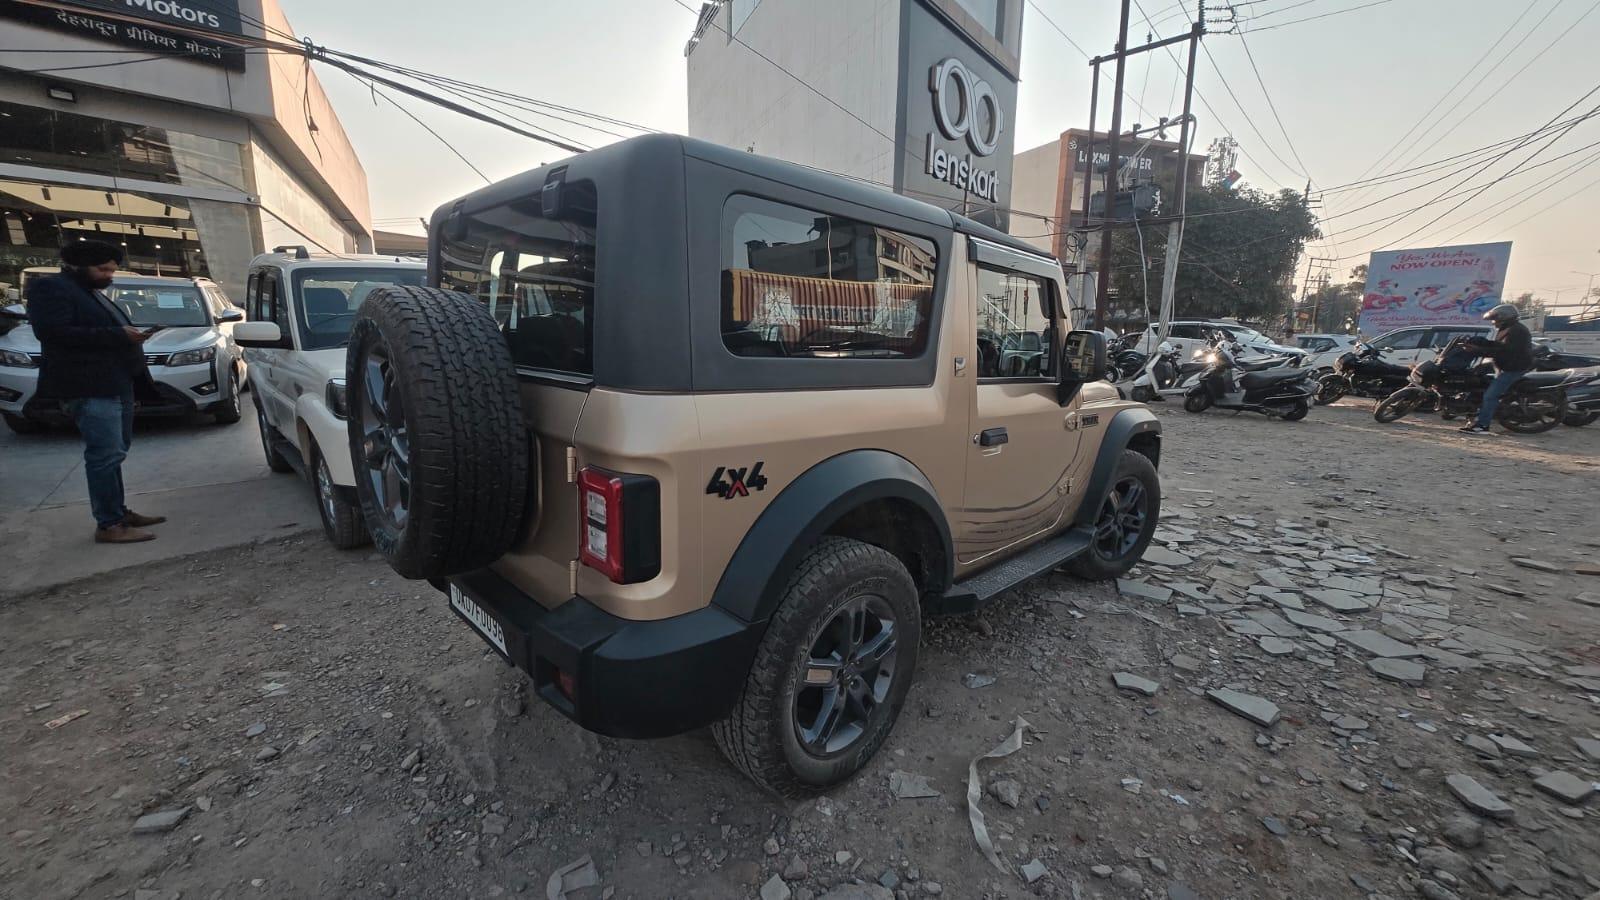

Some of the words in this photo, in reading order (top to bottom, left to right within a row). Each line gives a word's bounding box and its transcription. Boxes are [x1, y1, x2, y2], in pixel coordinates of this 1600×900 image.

[126, 27, 177, 49] प्रीमियर
[926, 132, 999, 202] lenskart
[1391, 261, 1428, 271] NOW
[1430, 258, 1480, 268] OPEN!
